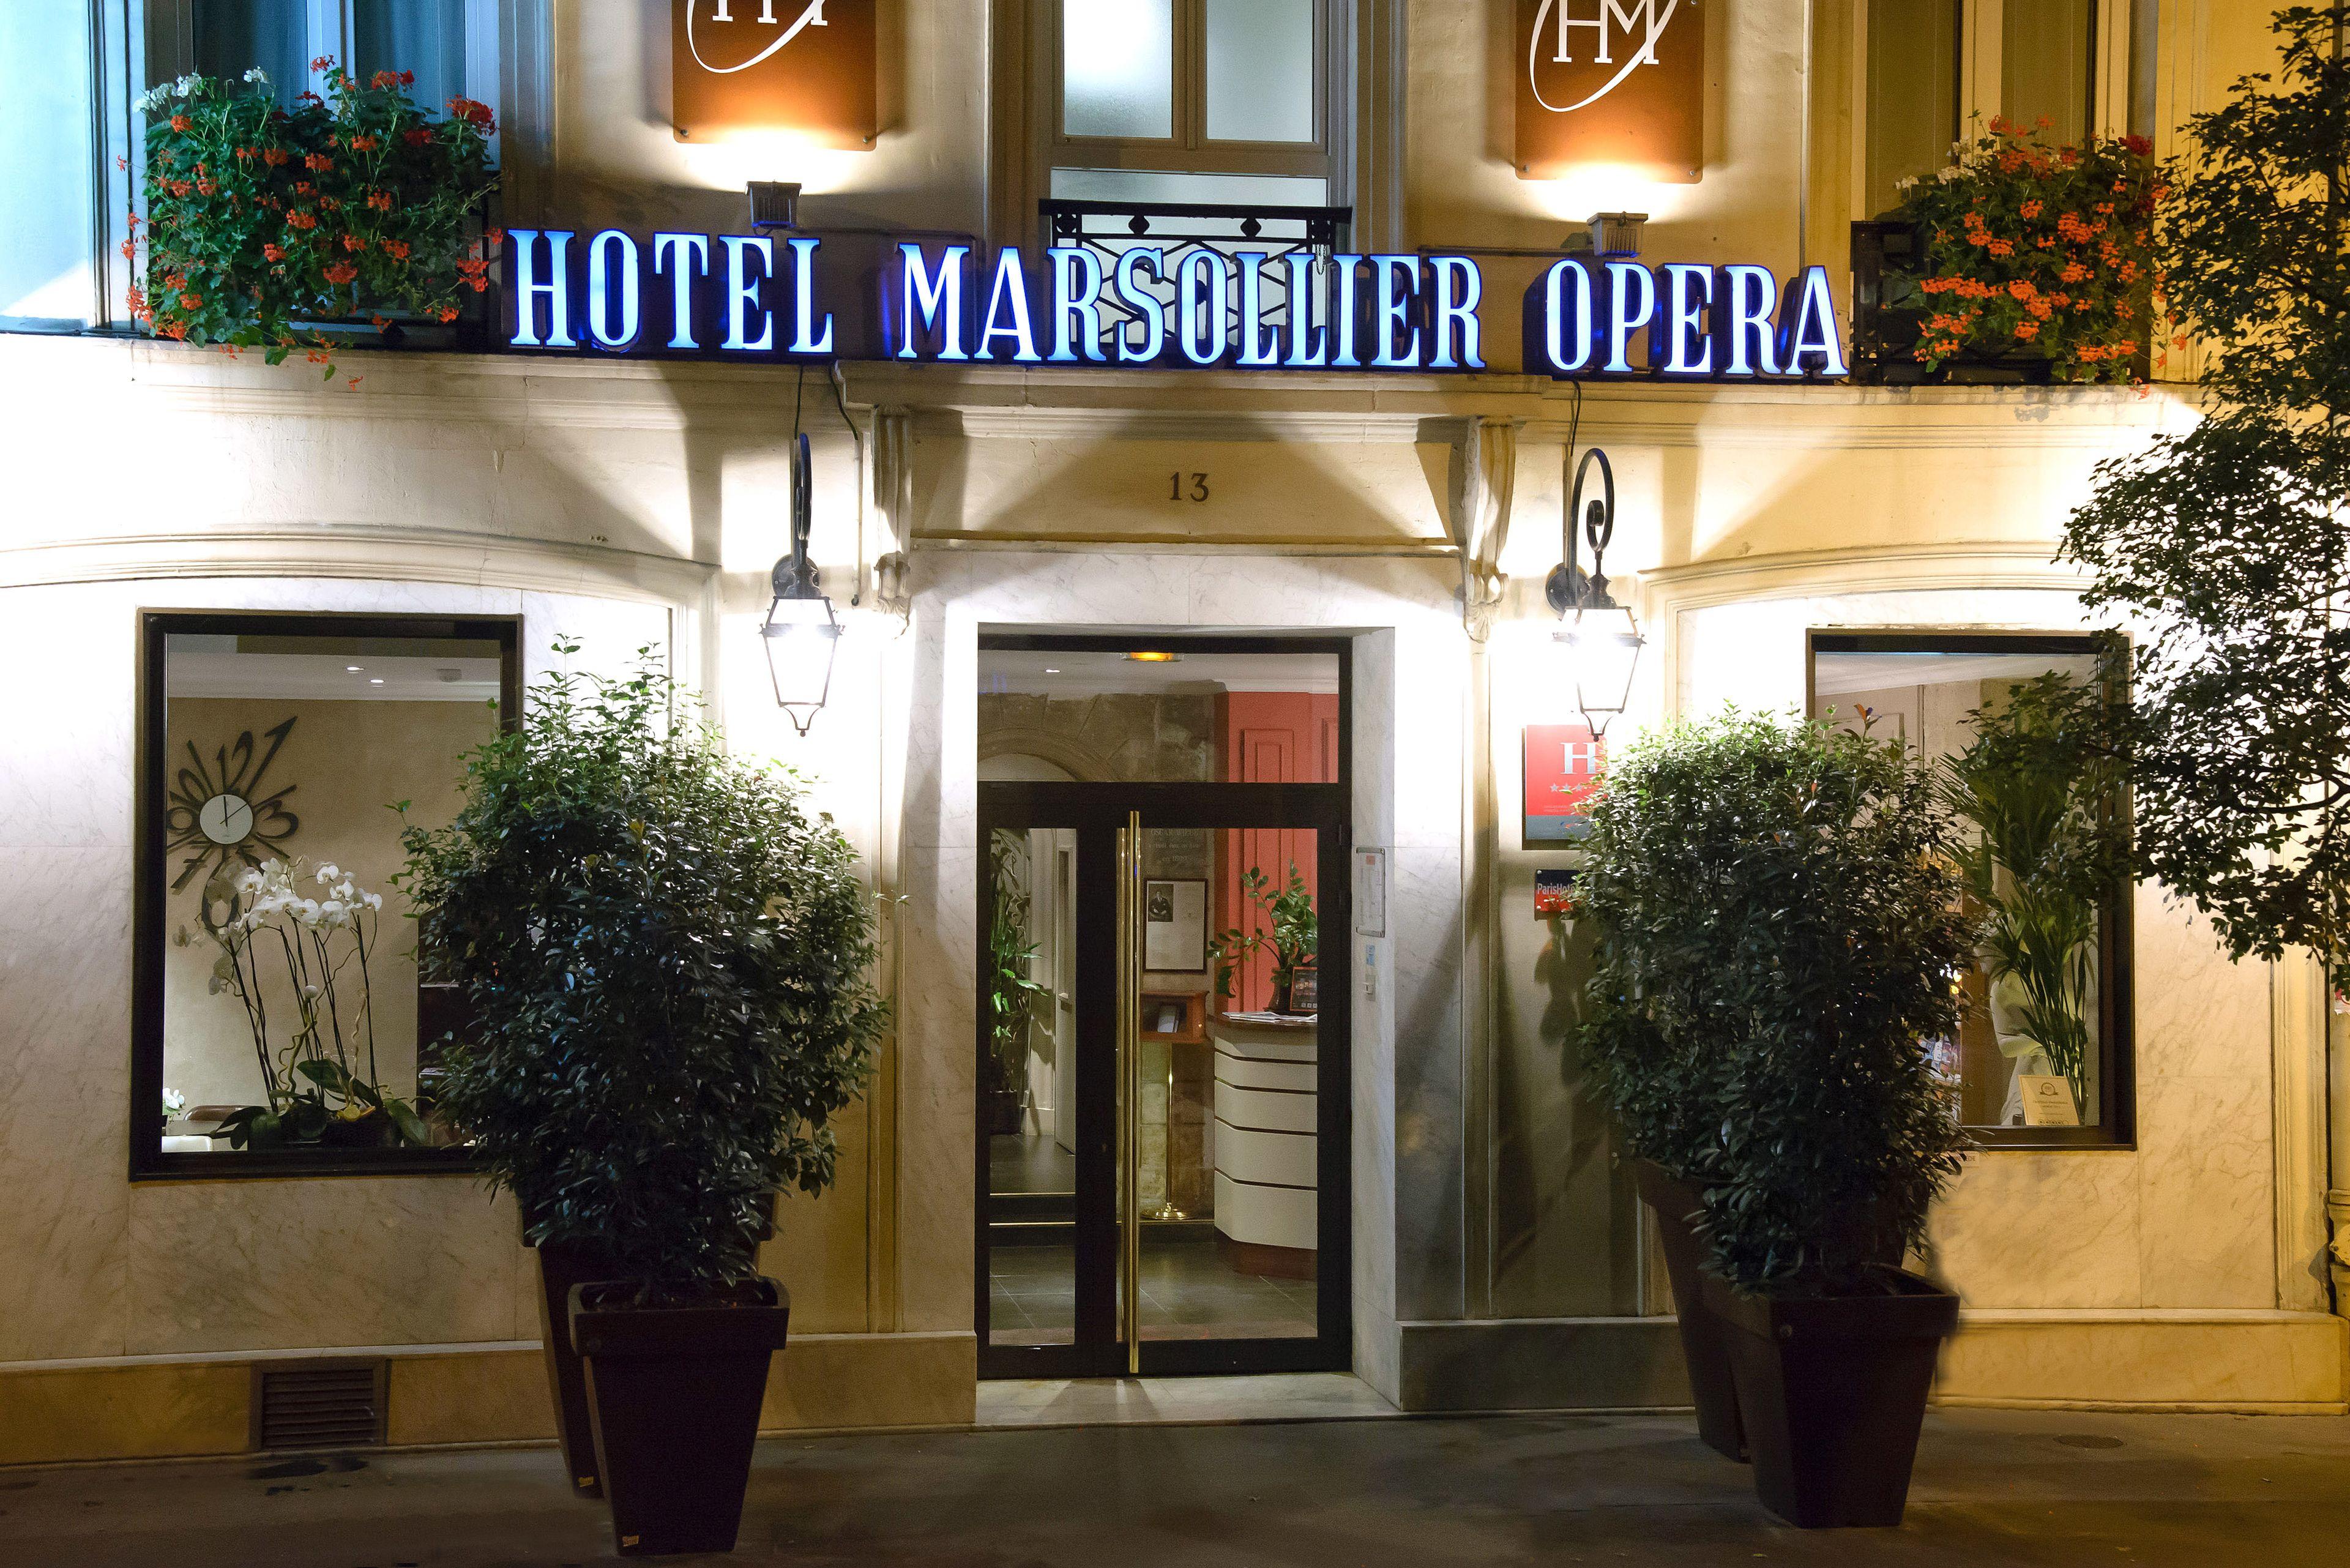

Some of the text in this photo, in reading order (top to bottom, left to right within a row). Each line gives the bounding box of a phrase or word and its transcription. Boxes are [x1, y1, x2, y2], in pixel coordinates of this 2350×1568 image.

[507, 228, 1849, 376] HOTEL MARSOLLIER OPERA
[1169, 471, 1209, 502] 13
[1560, 742, 1598, 774] H
